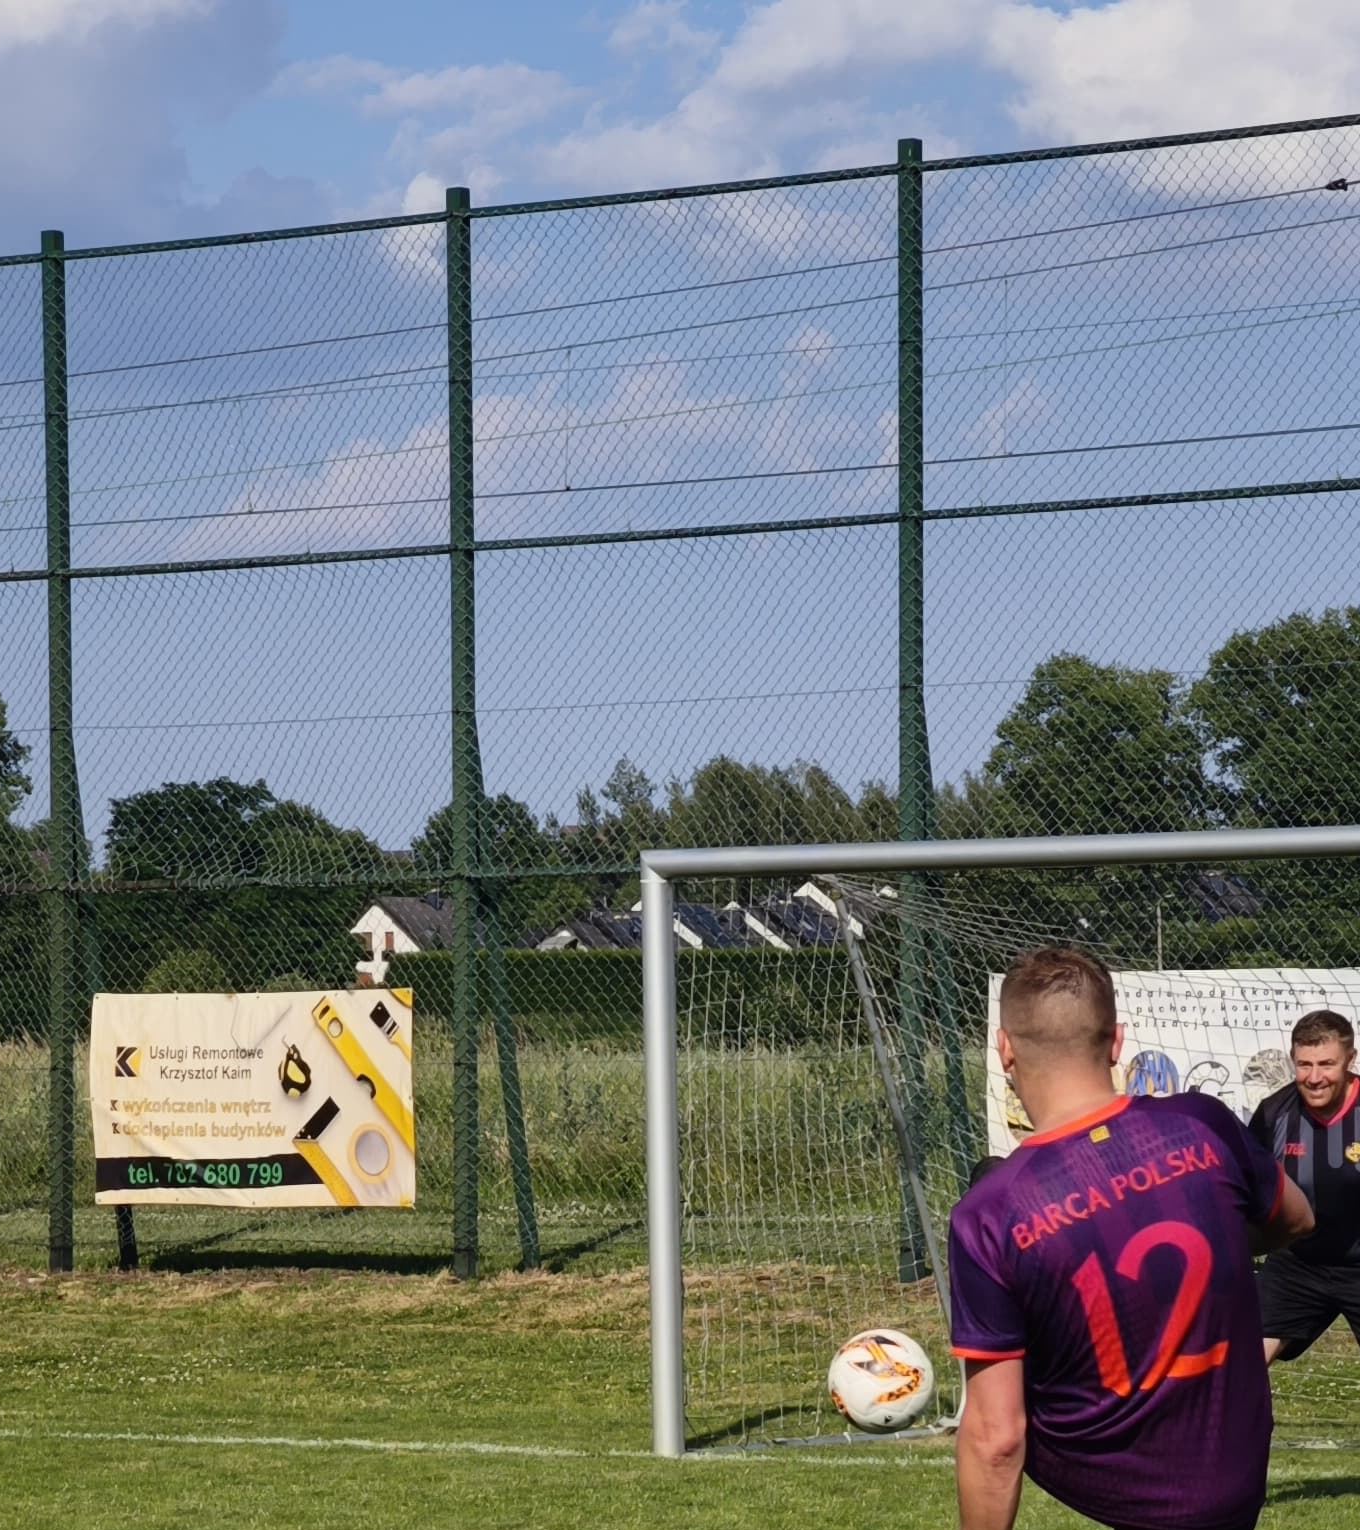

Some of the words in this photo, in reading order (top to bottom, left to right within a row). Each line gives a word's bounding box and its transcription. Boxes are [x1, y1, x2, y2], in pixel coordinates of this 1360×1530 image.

[149, 1046, 188, 1063] Usługi
[192, 1045, 264, 1060] Remontowe
[160, 1065, 218, 1082] Krzysztof
[222, 1066, 252, 1079] Kaim
[122, 1098, 217, 1116] wykończenia
[221, 1100, 271, 1117] wnętrz
[122, 1121, 208, 1140] docieplenia
[211, 1122, 286, 1140] budynków
[128, 1164, 159, 1184] tel.
[164, 1163, 197, 1184] 782
[203, 1163, 240, 1184] 680
[247, 1163, 283, 1184] 799
[1109, 1141, 1220, 1200] POLSKA
[1072, 1221, 1229, 1397] 12
